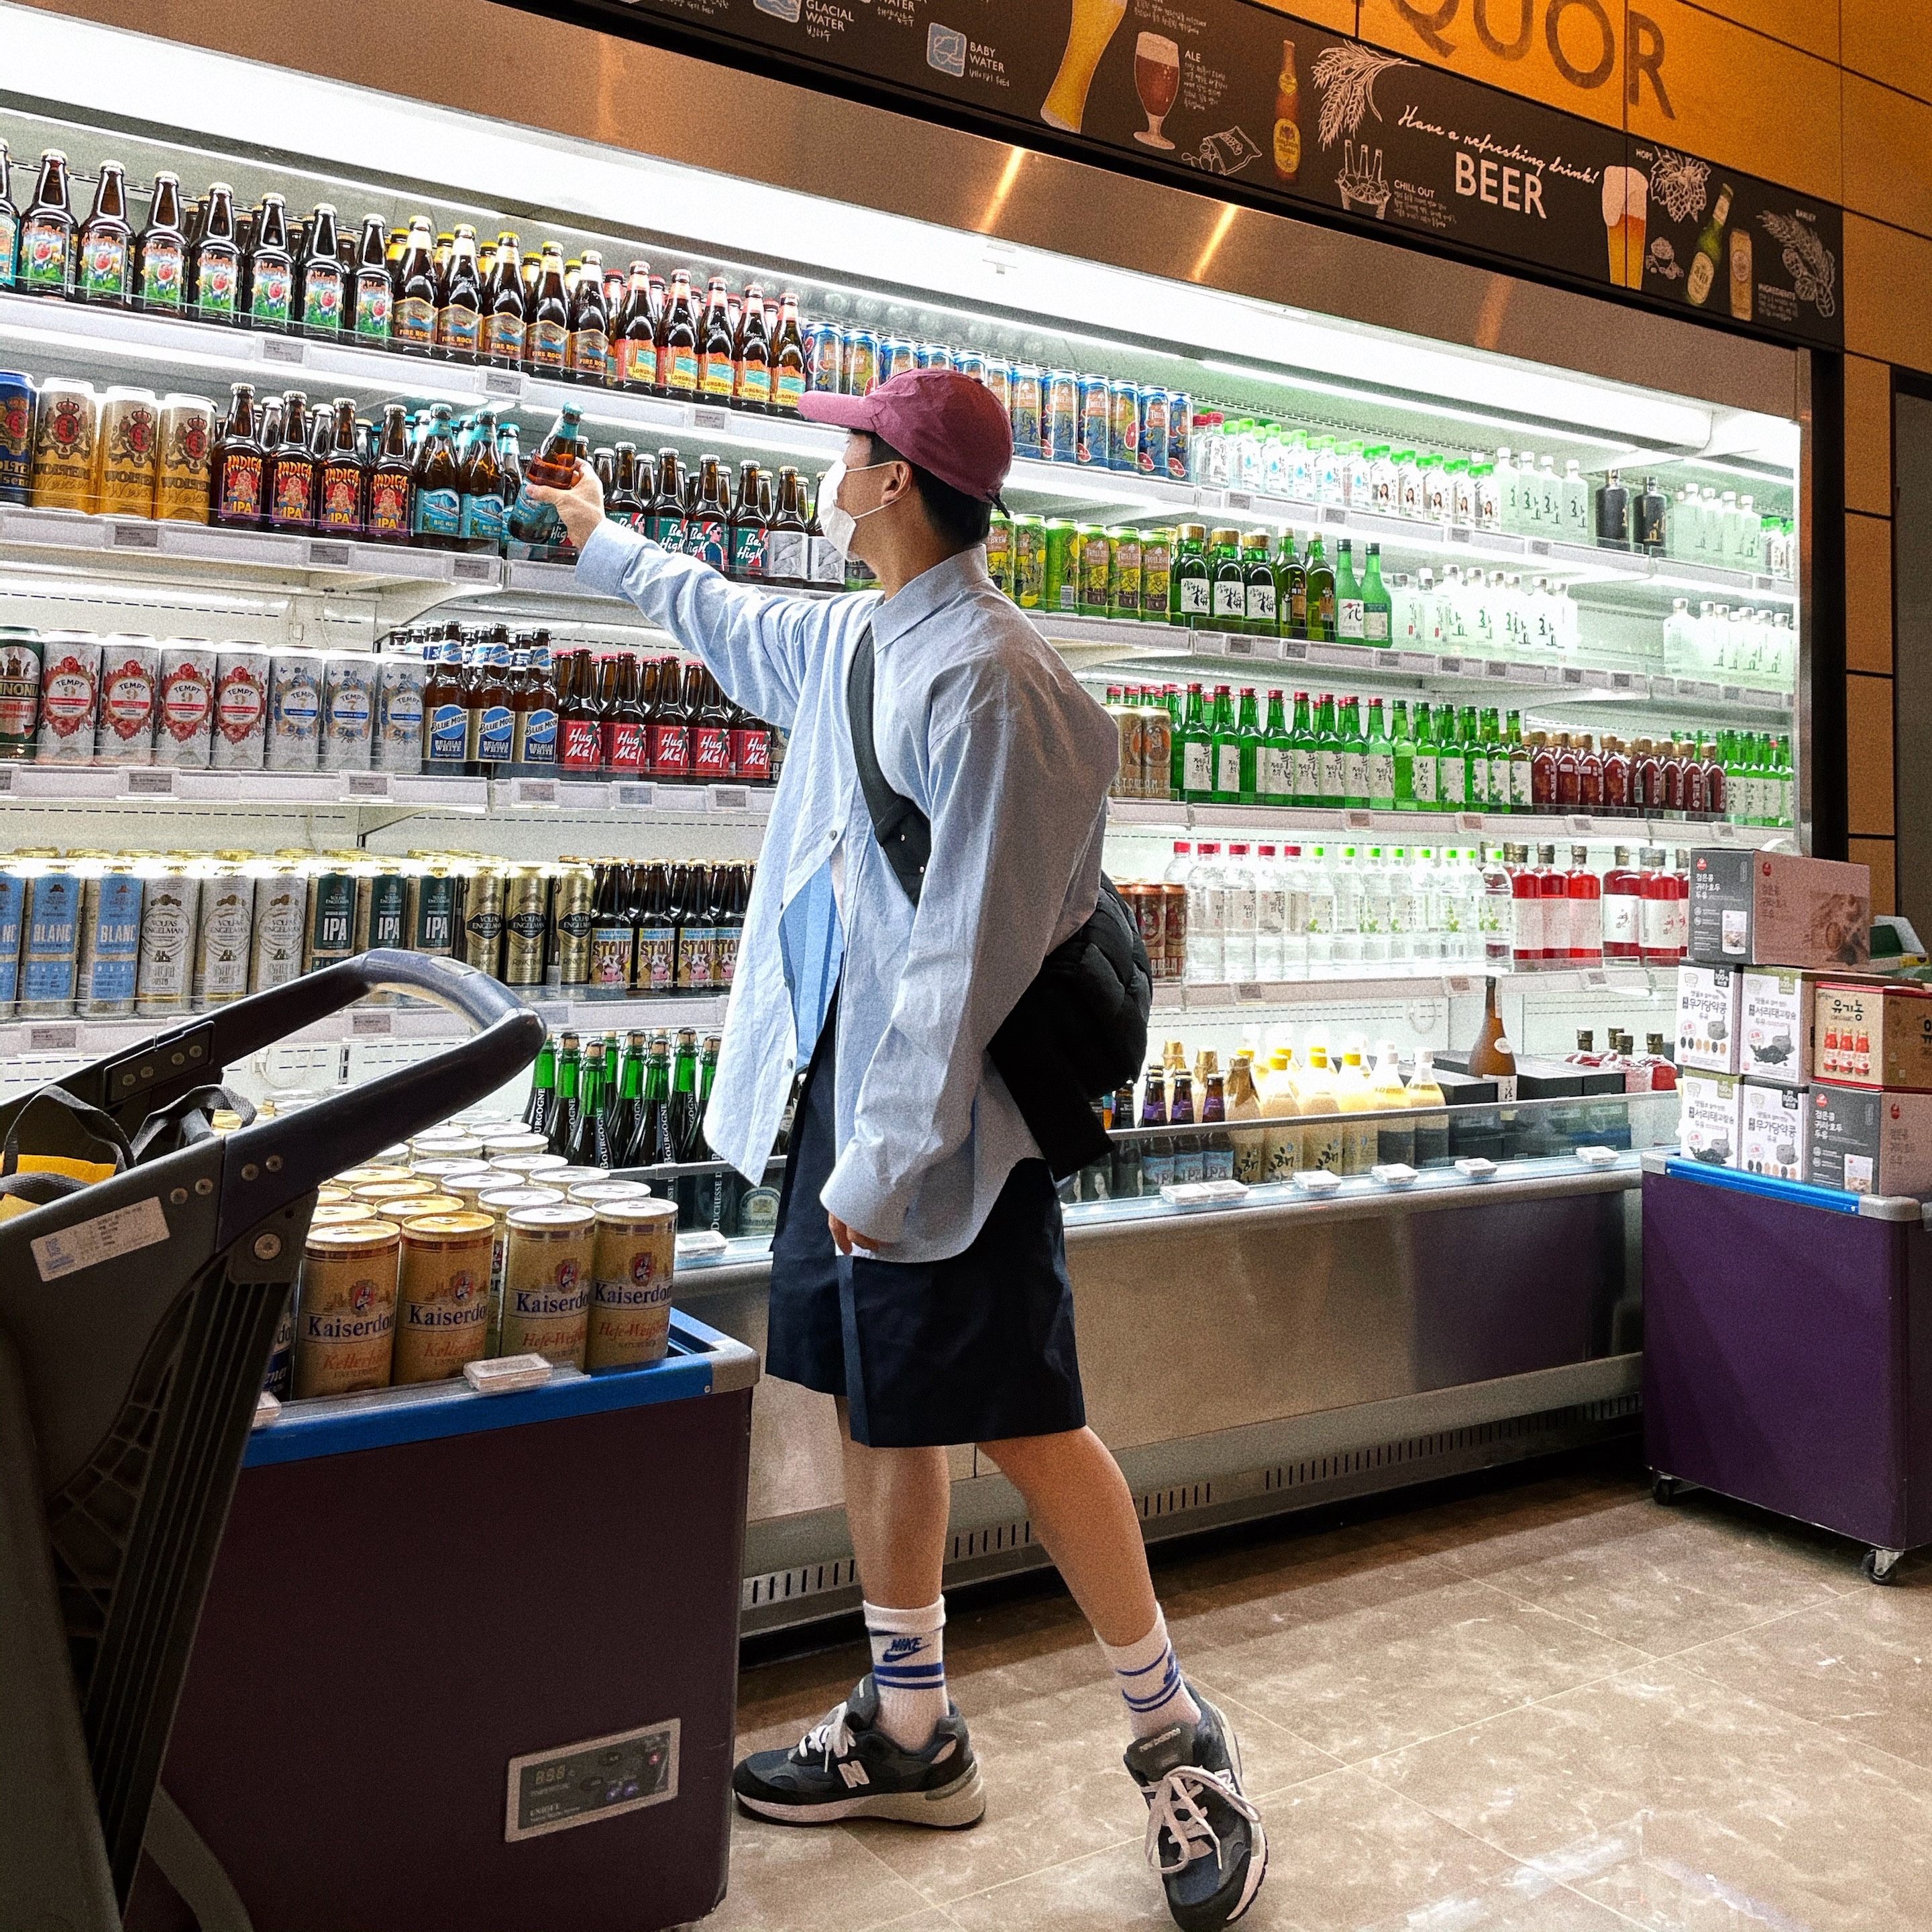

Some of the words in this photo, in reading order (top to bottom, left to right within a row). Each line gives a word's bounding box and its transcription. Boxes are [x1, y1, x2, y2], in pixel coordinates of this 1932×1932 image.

[807, 1, 855, 22] GLACIAL
[806, 11, 845, 32] WATER
[970, 42, 996, 58] BABY
[1185, 50, 1201, 62] ALE
[969, 53, 1005, 73] WATER
[1397, 105, 1445, 136] Have
[1448, 130, 1460, 141] a
[1463, 133, 1546, 177] refreshing
[1548, 156, 1600, 185] drink!
[1394, 179, 1415, 194] CHILL
[1417, 186, 1435, 199] OUT
[1455, 151, 1547, 219] BEER
[232, 499, 253, 515] IPA
[282, 506, 304, 520] IPA
[330, 511, 351, 525] IPA
[377, 517, 397, 529] IPA
[551, 527, 568, 543] Hig
[56, 679, 85, 688] TEMPT
[118, 682, 146, 692] TEMPT
[174, 686, 201, 694] TEMPT
[64, 686, 76, 697] 9
[126, 688, 138, 700] 9
[181, 692, 193, 702] 9
[227, 688, 254, 696] TEMPT
[290, 691, 315, 700] TEMPT
[340, 694, 366, 702] TEMPT
[235, 694, 246, 705] 9
[396, 696, 421, 704] TEMPT
[431, 720, 449, 733] BLUE
[478, 721, 498, 733] BLUE
[525, 724, 543, 736] BLUE
[569, 729, 593, 743] Hug
[617, 733, 640, 747] Hug
[661, 733, 684, 748] Hug
[700, 736, 722, 751] Hug
[747, 738, 767, 752] Hug
[1695, 891, 1707, 899] 두유
[34, 924, 72, 942] BLANC
[101, 924, 136, 943] BLANC
[323, 918, 347, 941] IPA
[378, 917, 400, 940] IPA
[425, 916, 447, 939] IPA
[592, 941, 631, 957] STOUT
[1831, 999, 1864, 1021] 유기농
[597, 1107, 609, 1169] BOURGOGNE
[661, 1104, 672, 1163] BOURGOGNE
[1815, 1130, 1828, 1140] 두유
[710, 1181, 722, 1231] DUCHESSE
[890, 1637, 922, 1652] NIKE
[837, 1760, 870, 1789] N
